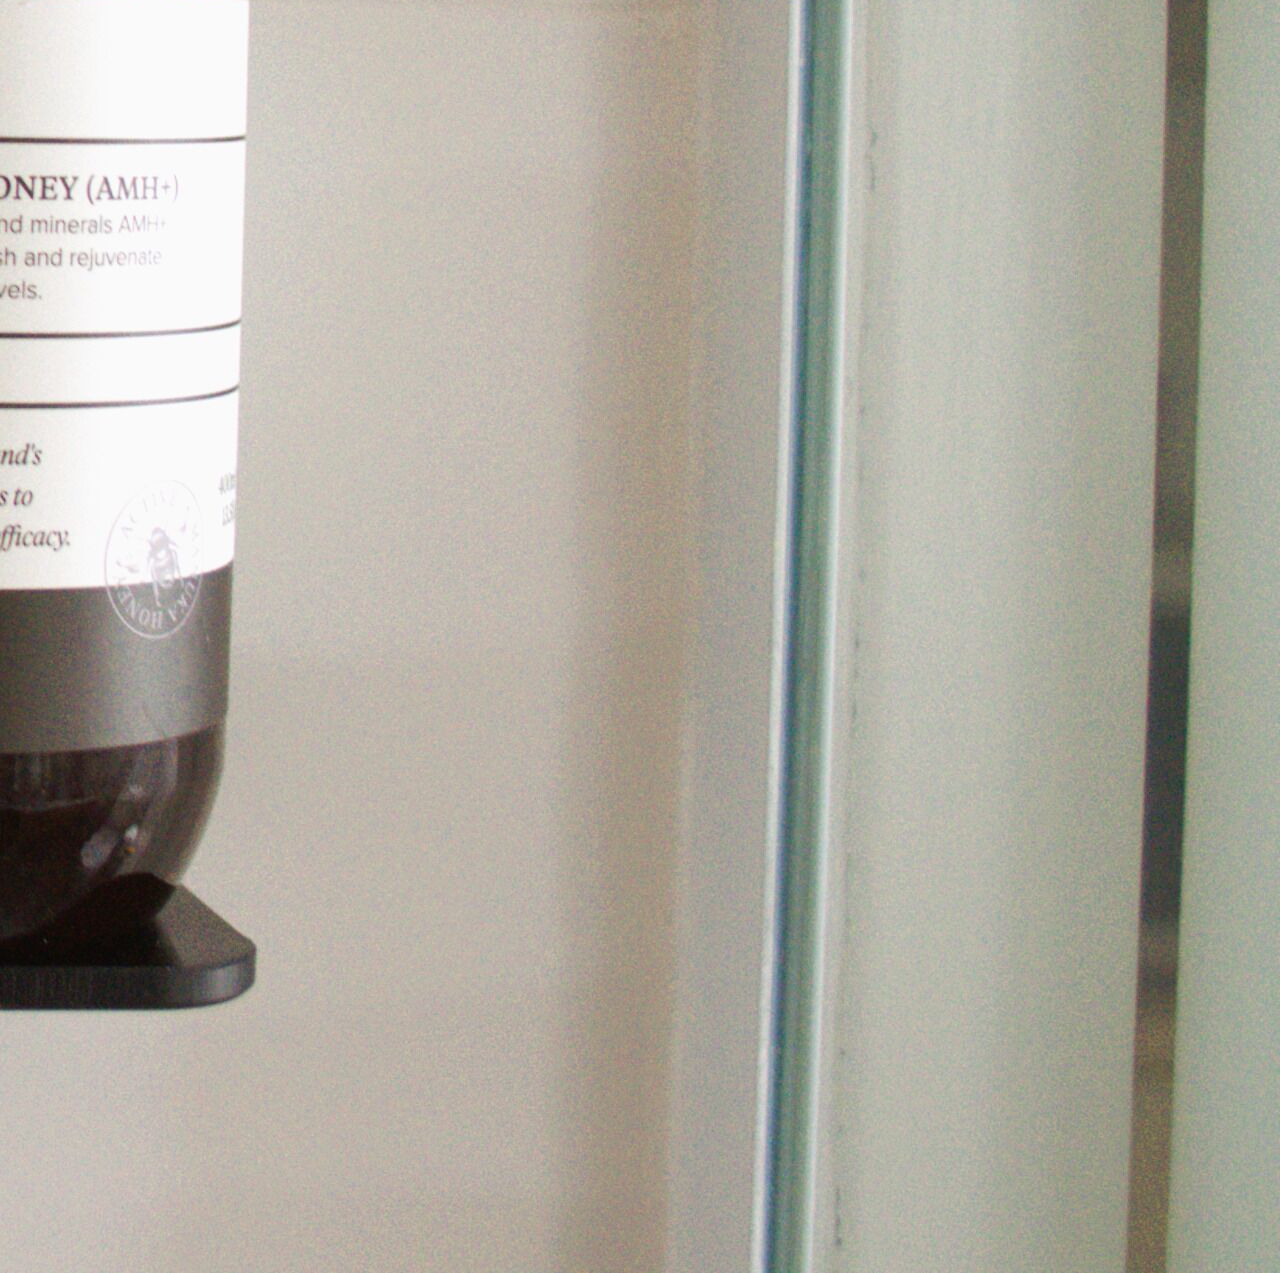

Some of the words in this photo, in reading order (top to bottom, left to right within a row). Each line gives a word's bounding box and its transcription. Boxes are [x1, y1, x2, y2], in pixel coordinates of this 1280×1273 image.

[87, 174, 178, 204] (AMH+)
[31, 215, 112, 233] minerals
[119, 215, 166, 233] AMH+
[24, 247, 62, 267] and
[70, 249, 161, 271] rejuvenate
[13, 486, 33, 506] to
